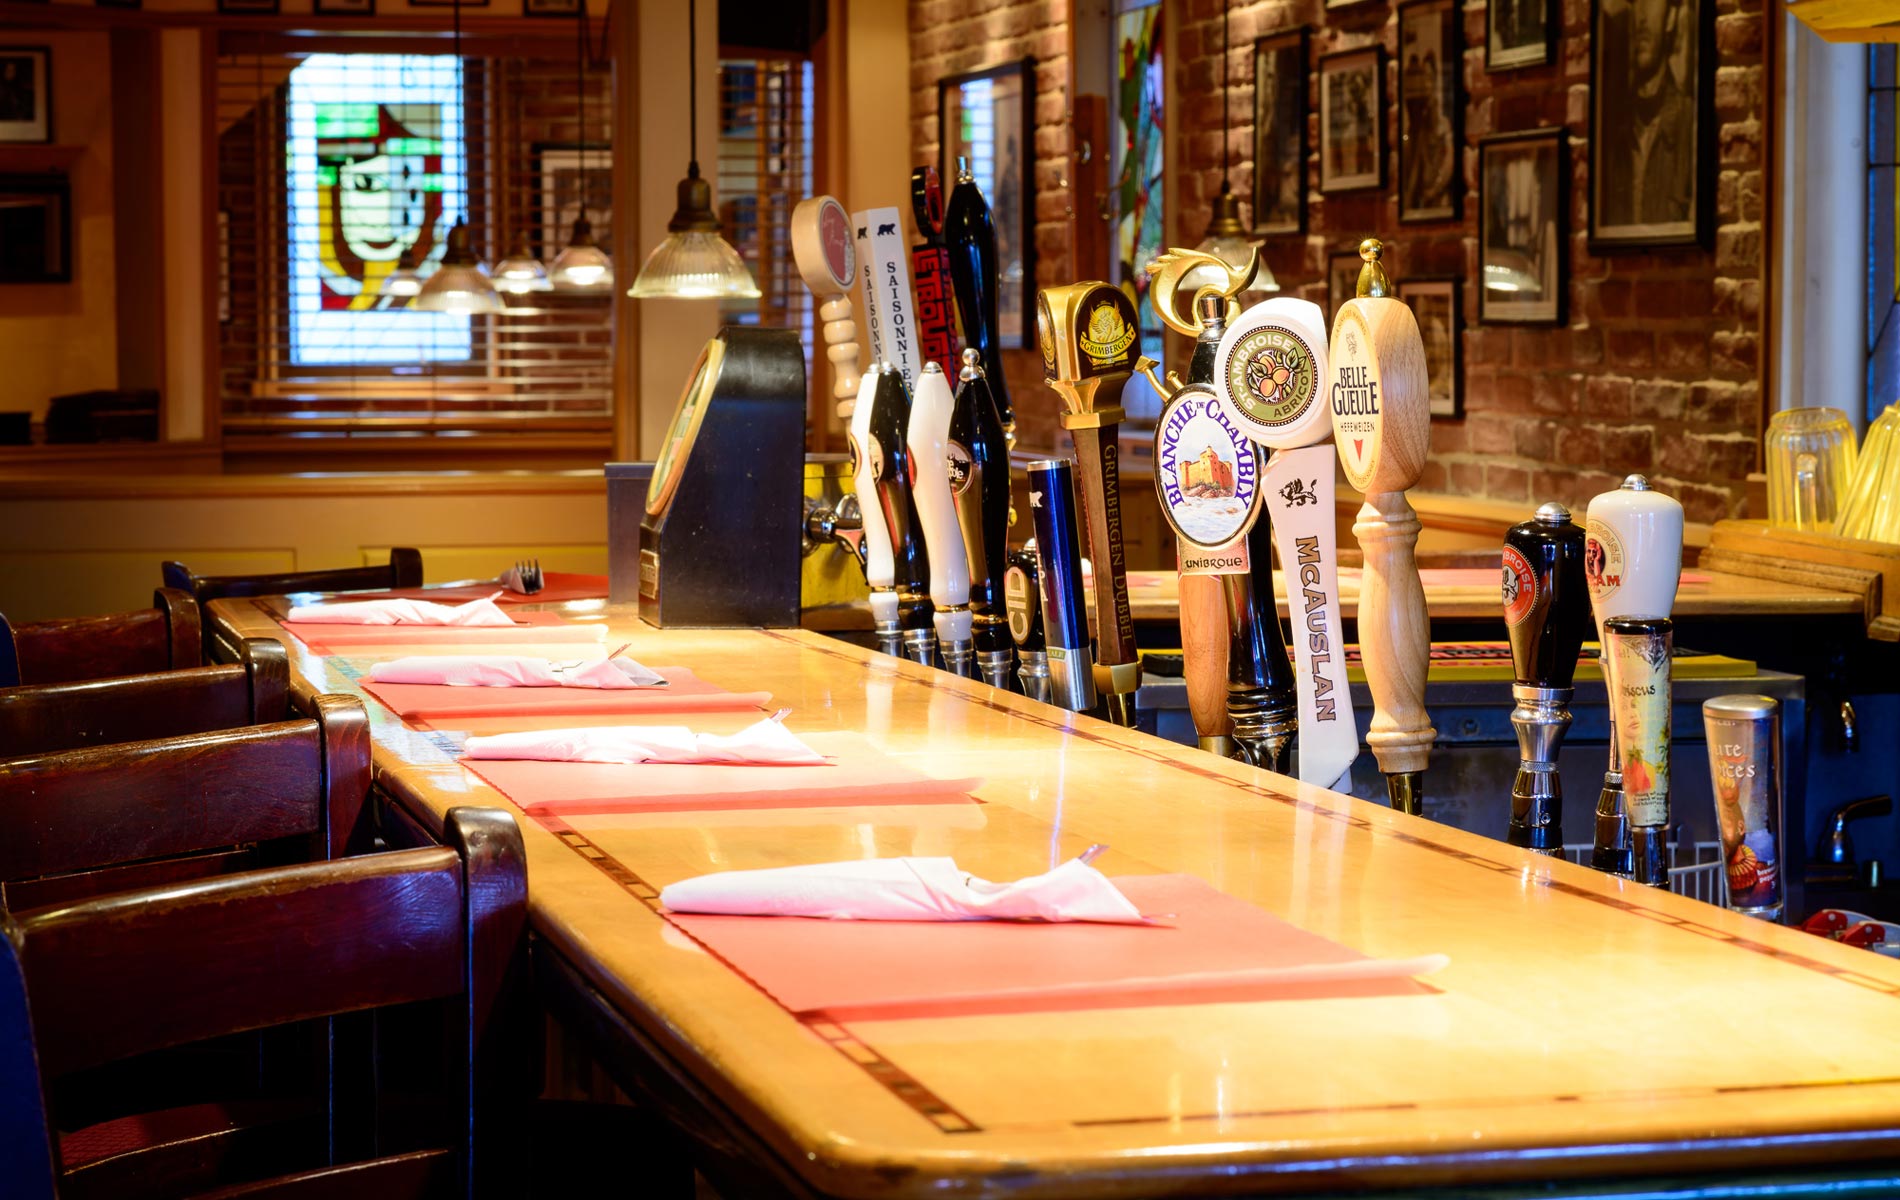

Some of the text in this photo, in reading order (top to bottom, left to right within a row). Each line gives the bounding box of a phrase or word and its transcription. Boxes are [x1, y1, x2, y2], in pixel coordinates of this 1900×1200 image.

[863, 265, 884, 366] SAISONNI
[1083, 334, 1132, 356] GRIMBERGEN
[1232, 334, 1294, 411] ST-AMBROISE
[1331, 381, 1380, 416] GUEULE
[1339, 366, 1369, 389] BELLE
[1162, 399, 1255, 510] BLANCHE DE CHAMBLY
[1340, 421, 1375, 432] HEFEWEIZEN
[1103, 444, 1133, 646] GRIMBERGEN DUBBEL
[1503, 550, 1532, 592] BROISE
[1295, 536, 1337, 721] MCAUSLAN
